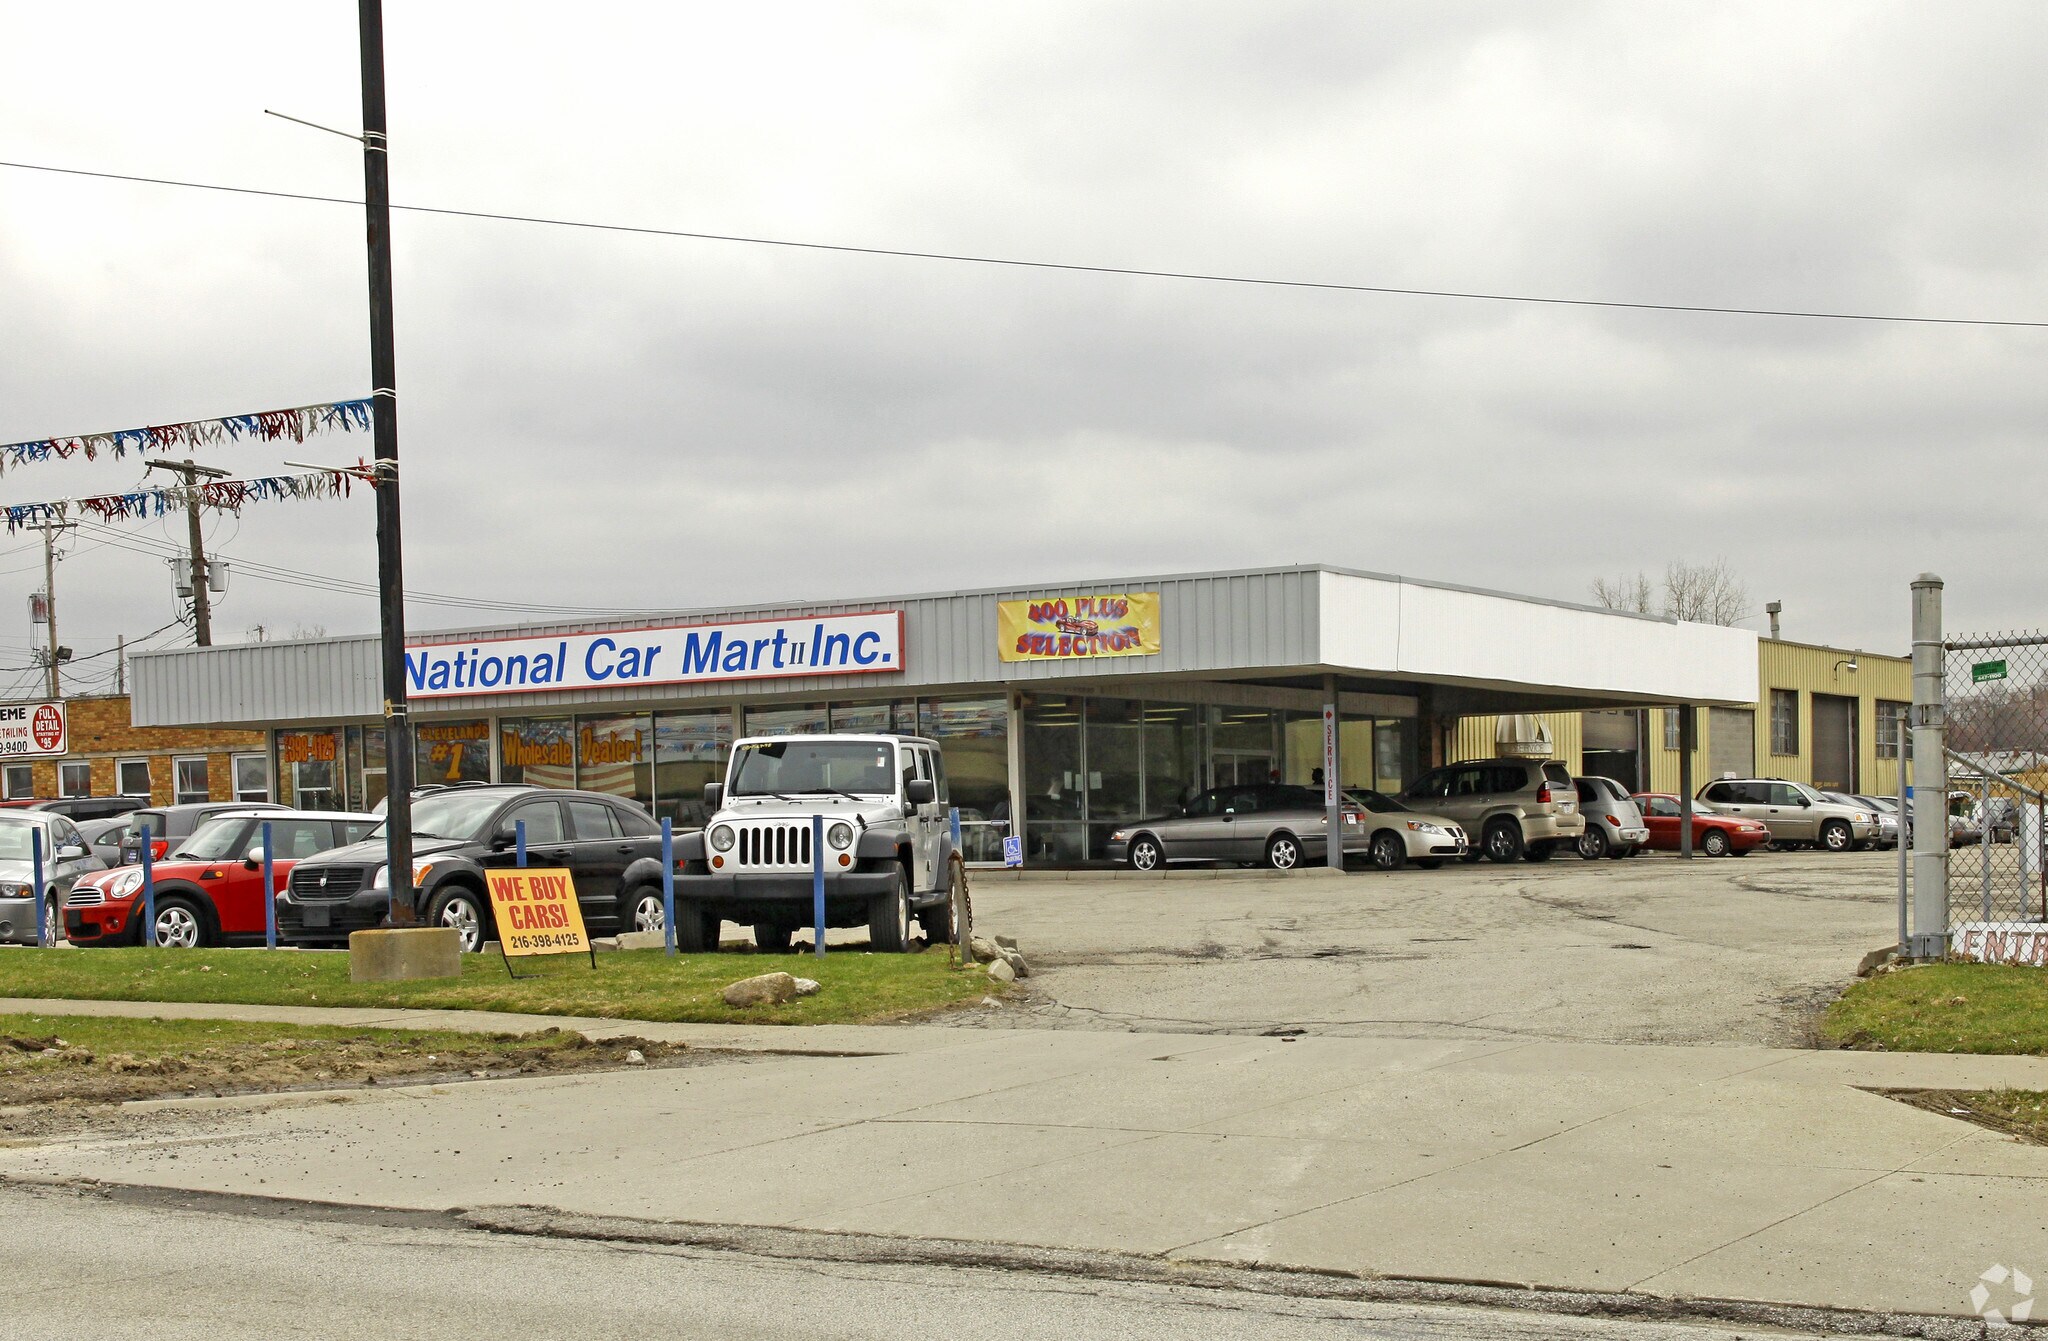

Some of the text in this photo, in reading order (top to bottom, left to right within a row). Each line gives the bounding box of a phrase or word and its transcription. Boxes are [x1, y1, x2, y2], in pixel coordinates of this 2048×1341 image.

[1075, 598, 1129, 618] PLUS
[1016, 628, 1142, 656] SELECTION
[405, 642, 567, 690] National
[585, 638, 662, 681] Car
[682, 629, 788, 674] Mart
[810, 624, 892, 667] Inc.
[0, 708, 26, 720] EME
[39, 709, 56, 719] FULL
[0, 727, 28, 739] TAILING
[36, 720, 59, 731] DETAIL
[420, 722, 489, 741] CLEVELAND'S
[41, 738, 52, 749] $95
[503, 727, 643, 766] Wholesale Dealer!
[430, 742, 465, 779] #1
[491, 876, 567, 901] WE BUY
[509, 904, 569, 929] CARS!
